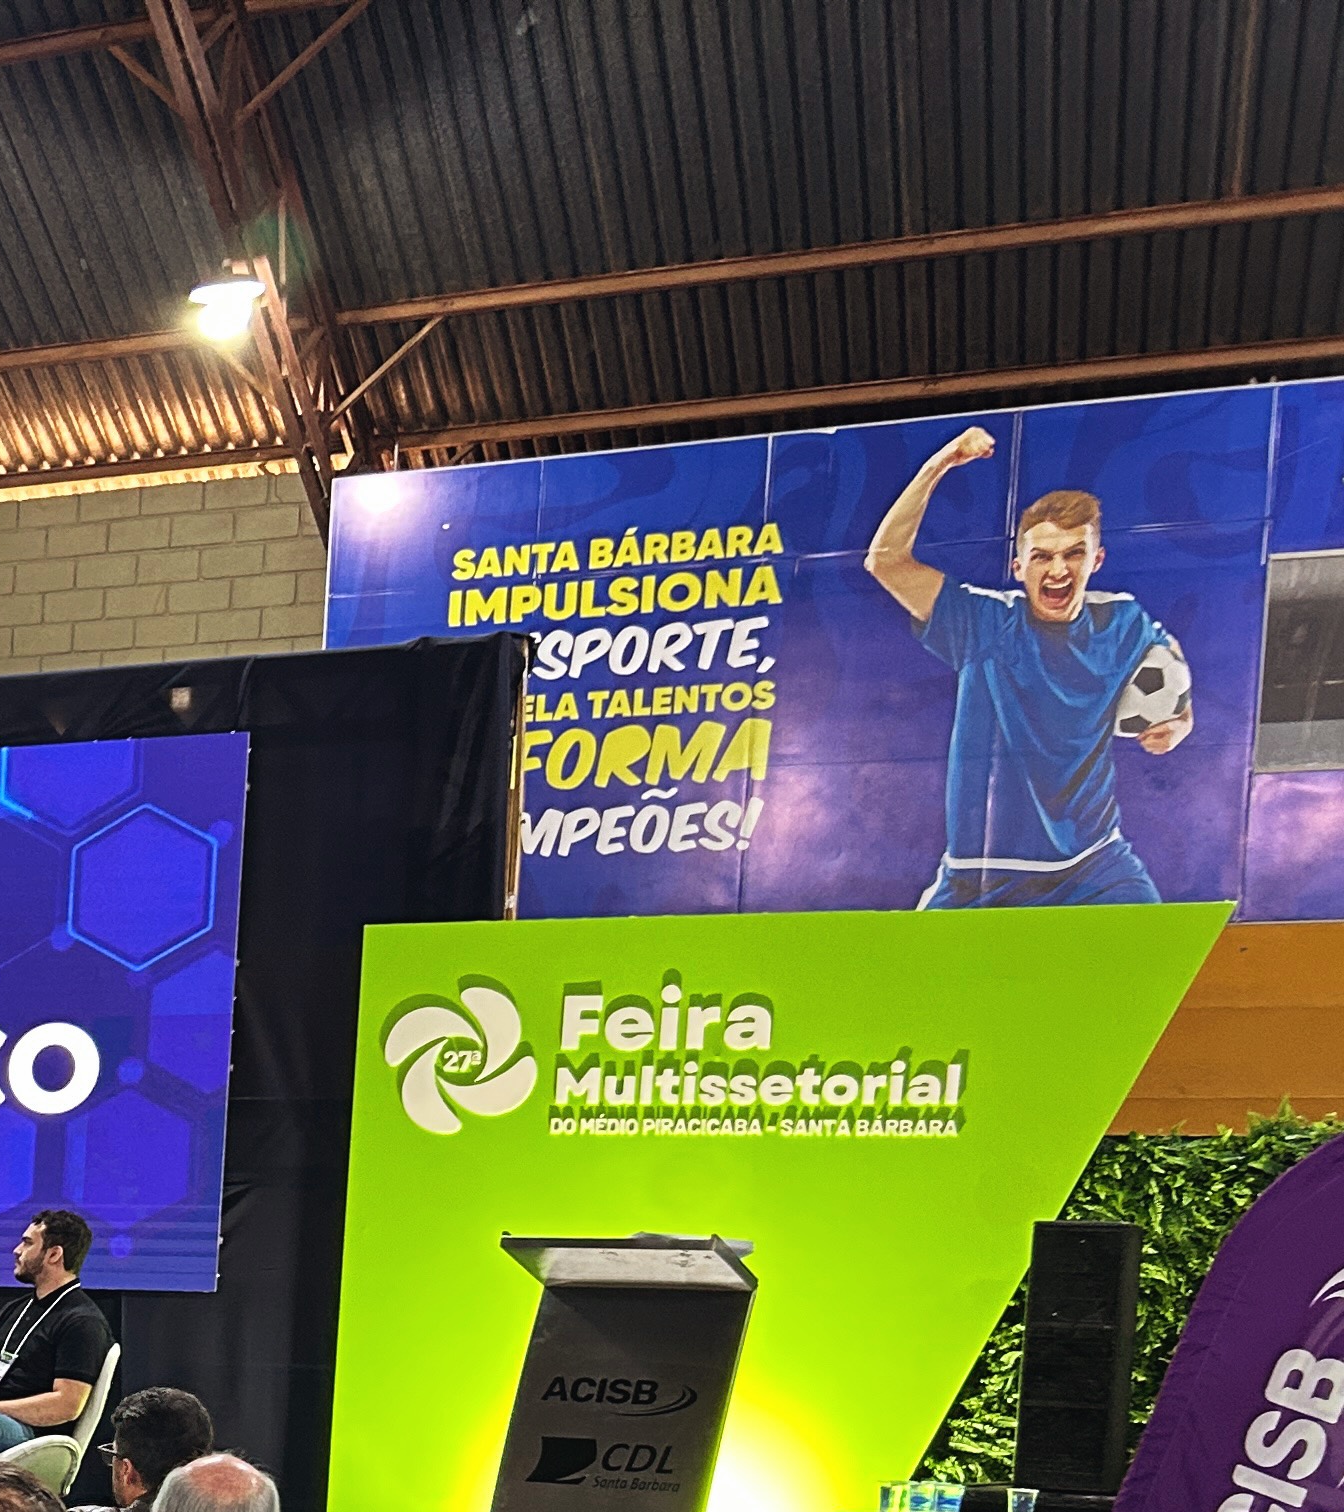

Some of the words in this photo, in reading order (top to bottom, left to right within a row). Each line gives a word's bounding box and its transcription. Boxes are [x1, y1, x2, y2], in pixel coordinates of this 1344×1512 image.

[451, 540, 580, 581] SANTA
[588, 522, 784, 571] BÁRBARA
[447, 565, 784, 628] IMPULSIONA
[529, 616, 777, 681] SPORTE,
[525, 691, 579, 722] ELA
[587, 680, 777, 720] TALENTOS
[522, 717, 773, 790] FORMA
[520, 787, 765, 857] MPEÕES!
[560, 983, 773, 1052] Feira
[443, 1050, 482, 1072] 27ª
[555, 1060, 962, 1107] Multissetorial
[549, 1117, 577, 1135] DO
[579, 1113, 639, 1136] MÉDIO
[642, 1117, 763, 1137] PIRACICABA
[779, 1118, 851, 1137] SANTA
[855, 1114, 959, 1137] BÁRBARA
[541, 1376, 659, 1405] ACISB
[592, 1475, 627, 1490] Santa
[601, 1443, 673, 1475] CDL
